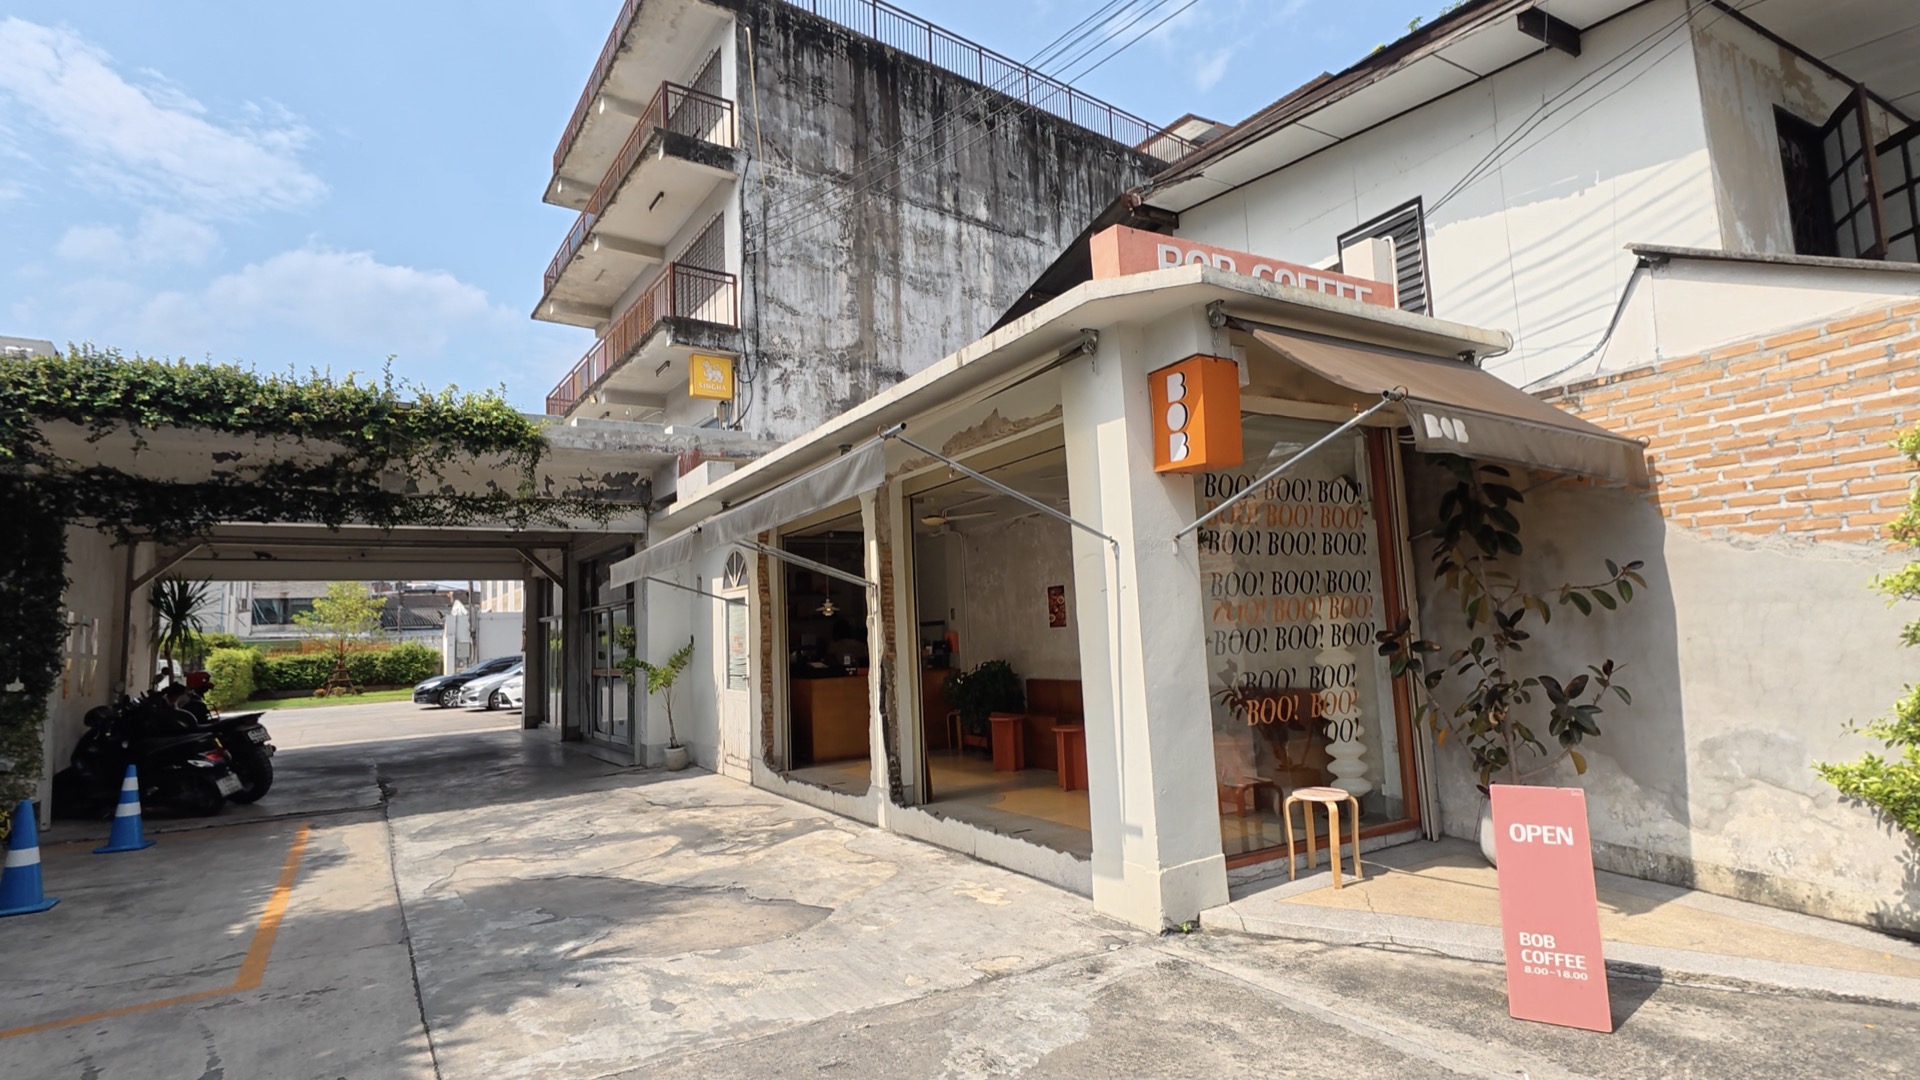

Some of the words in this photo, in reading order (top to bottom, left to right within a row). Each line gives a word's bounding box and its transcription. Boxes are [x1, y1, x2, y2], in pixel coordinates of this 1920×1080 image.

[698, 383, 727, 391] SINGHA
[1166, 372, 1190, 462] BOB
[1423, 413, 1469, 443] BOB
[1264, 477, 1312, 502] BOO!
[1317, 480, 1362, 505] BOO!
[1266, 503, 1315, 529] BOO!
[1319, 505, 1365, 530] BOO!
[1208, 530, 1261, 556] BOO!
[1268, 531, 1316, 556] BOO!
[1322, 532, 1367, 556] BOO!
[1211, 571, 1264, 597] BOO!
[1271, 571, 1320, 596] BOO!
[1327, 570, 1372, 594] BOO!
[1274, 597, 1322, 623] BOO!
[1329, 595, 1374, 620] BOO!
[1214, 627, 1268, 656] BOO!
[1275, 624, 1324, 651] BOO!
[1331, 622, 1376, 647] BOO!
[1309, 663, 1356, 690] BOO!
[1246, 694, 1299, 726] BOO!
[1310, 689, 1358, 718] BOO!
[1325, 717, 1360, 744] OO!
[1509, 823, 1574, 846] OPEN
[1519, 932, 1556, 949] BOB
[1521, 949, 1587, 970] COFFEE
